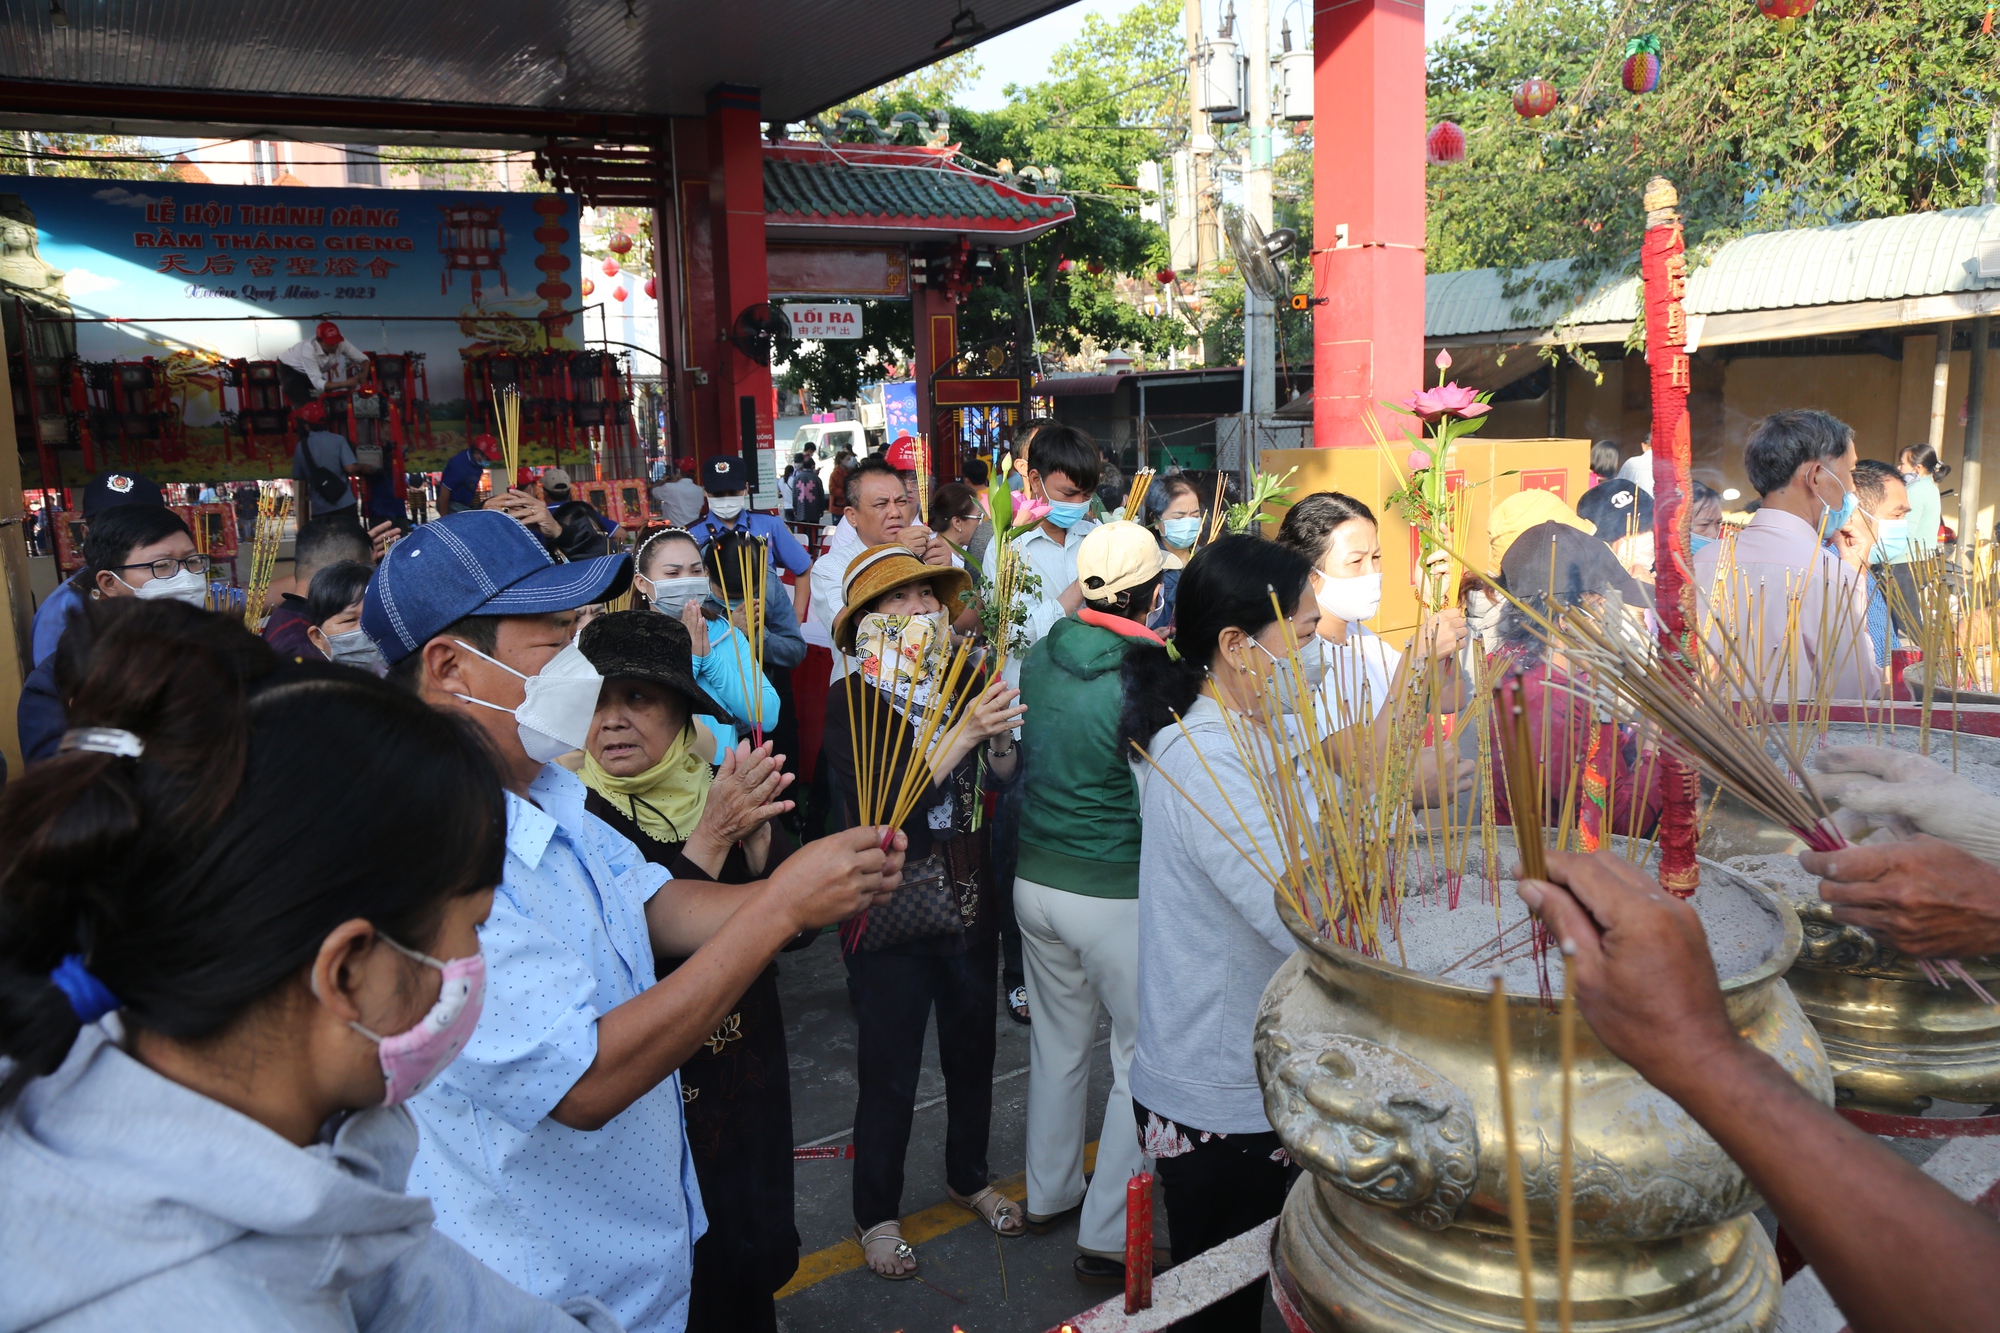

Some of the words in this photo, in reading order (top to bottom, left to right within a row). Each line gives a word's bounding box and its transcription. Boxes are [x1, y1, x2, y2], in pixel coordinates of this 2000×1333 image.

[146, 197, 175, 223] LỄ
[183, 201, 231, 228] HỘI
[239, 203, 324, 226] THÁNH
[134, 227, 203, 248] RẰM
[211, 231, 315, 250] THÁNG
[324, 233, 413, 251] GIÊNG
[333, 286, 376, 299] 2023
[793, 307, 822, 324] LỐI
[829, 312, 855, 324] RA
